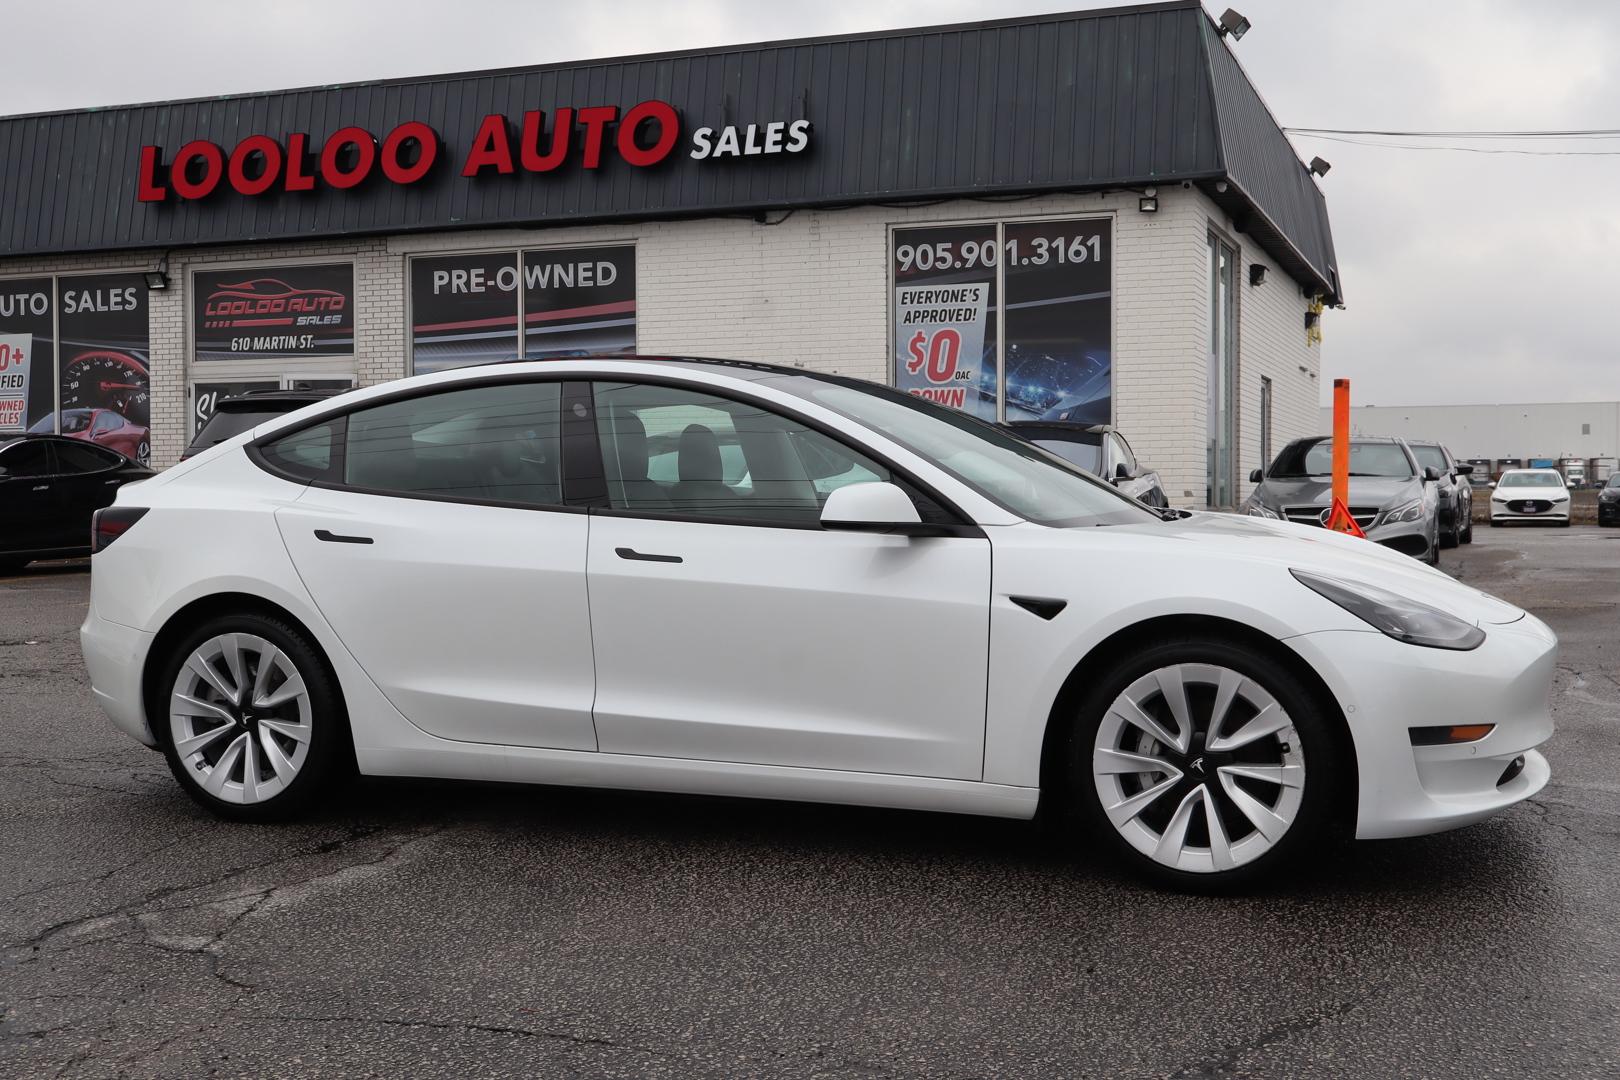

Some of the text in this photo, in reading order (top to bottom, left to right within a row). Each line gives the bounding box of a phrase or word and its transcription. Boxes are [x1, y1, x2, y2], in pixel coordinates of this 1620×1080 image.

[138, 100, 810, 202] LOOLOO AUTO SALES
[896, 234, 1101, 272] 905.901.3161
[433, 261, 617, 295] PRE-OWNED
[0, 287, 138, 317] UTO SALES
[205, 297, 345, 316] LOOLOO AUTO
[901, 288, 980, 305] EVERYONE'S
[296, 315, 342, 326] SALES
[903, 308, 977, 324] APPROVED!
[231, 335, 314, 351] 610 MARTIN ST.
[907, 329, 971, 382] $0 OAC
